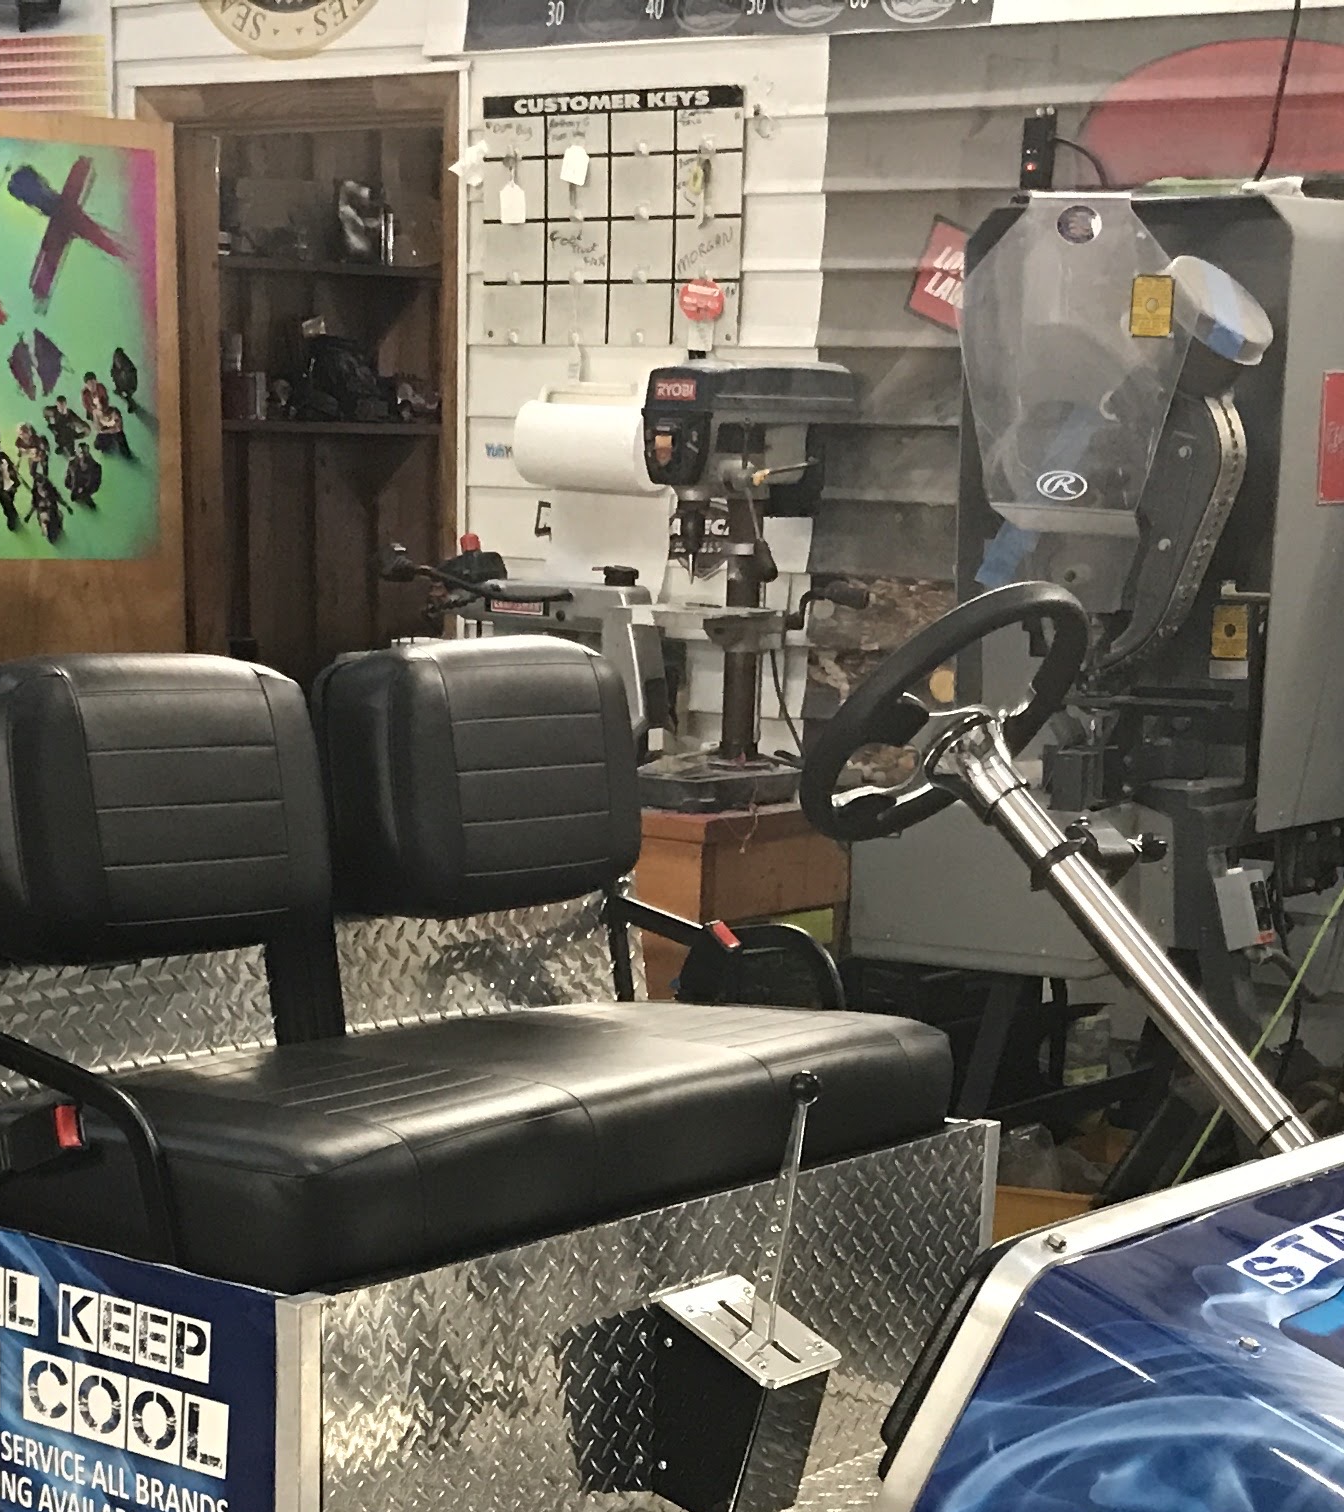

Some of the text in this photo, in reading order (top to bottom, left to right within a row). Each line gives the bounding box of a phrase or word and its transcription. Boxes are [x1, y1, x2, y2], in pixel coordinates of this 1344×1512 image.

[546, 1, 565, 26] 30
[514, 90, 710, 114] CUSTOMER KEYS
[677, 226, 734, 273] MORGAN
[657, 382, 694, 398] RYOBI
[61, 1290, 207, 1370] KEEP
[27, 1359, 224, 1471] COOL
[0, 1430, 85, 1485] SERVICE
[90, 1459, 130, 1501] ALL
